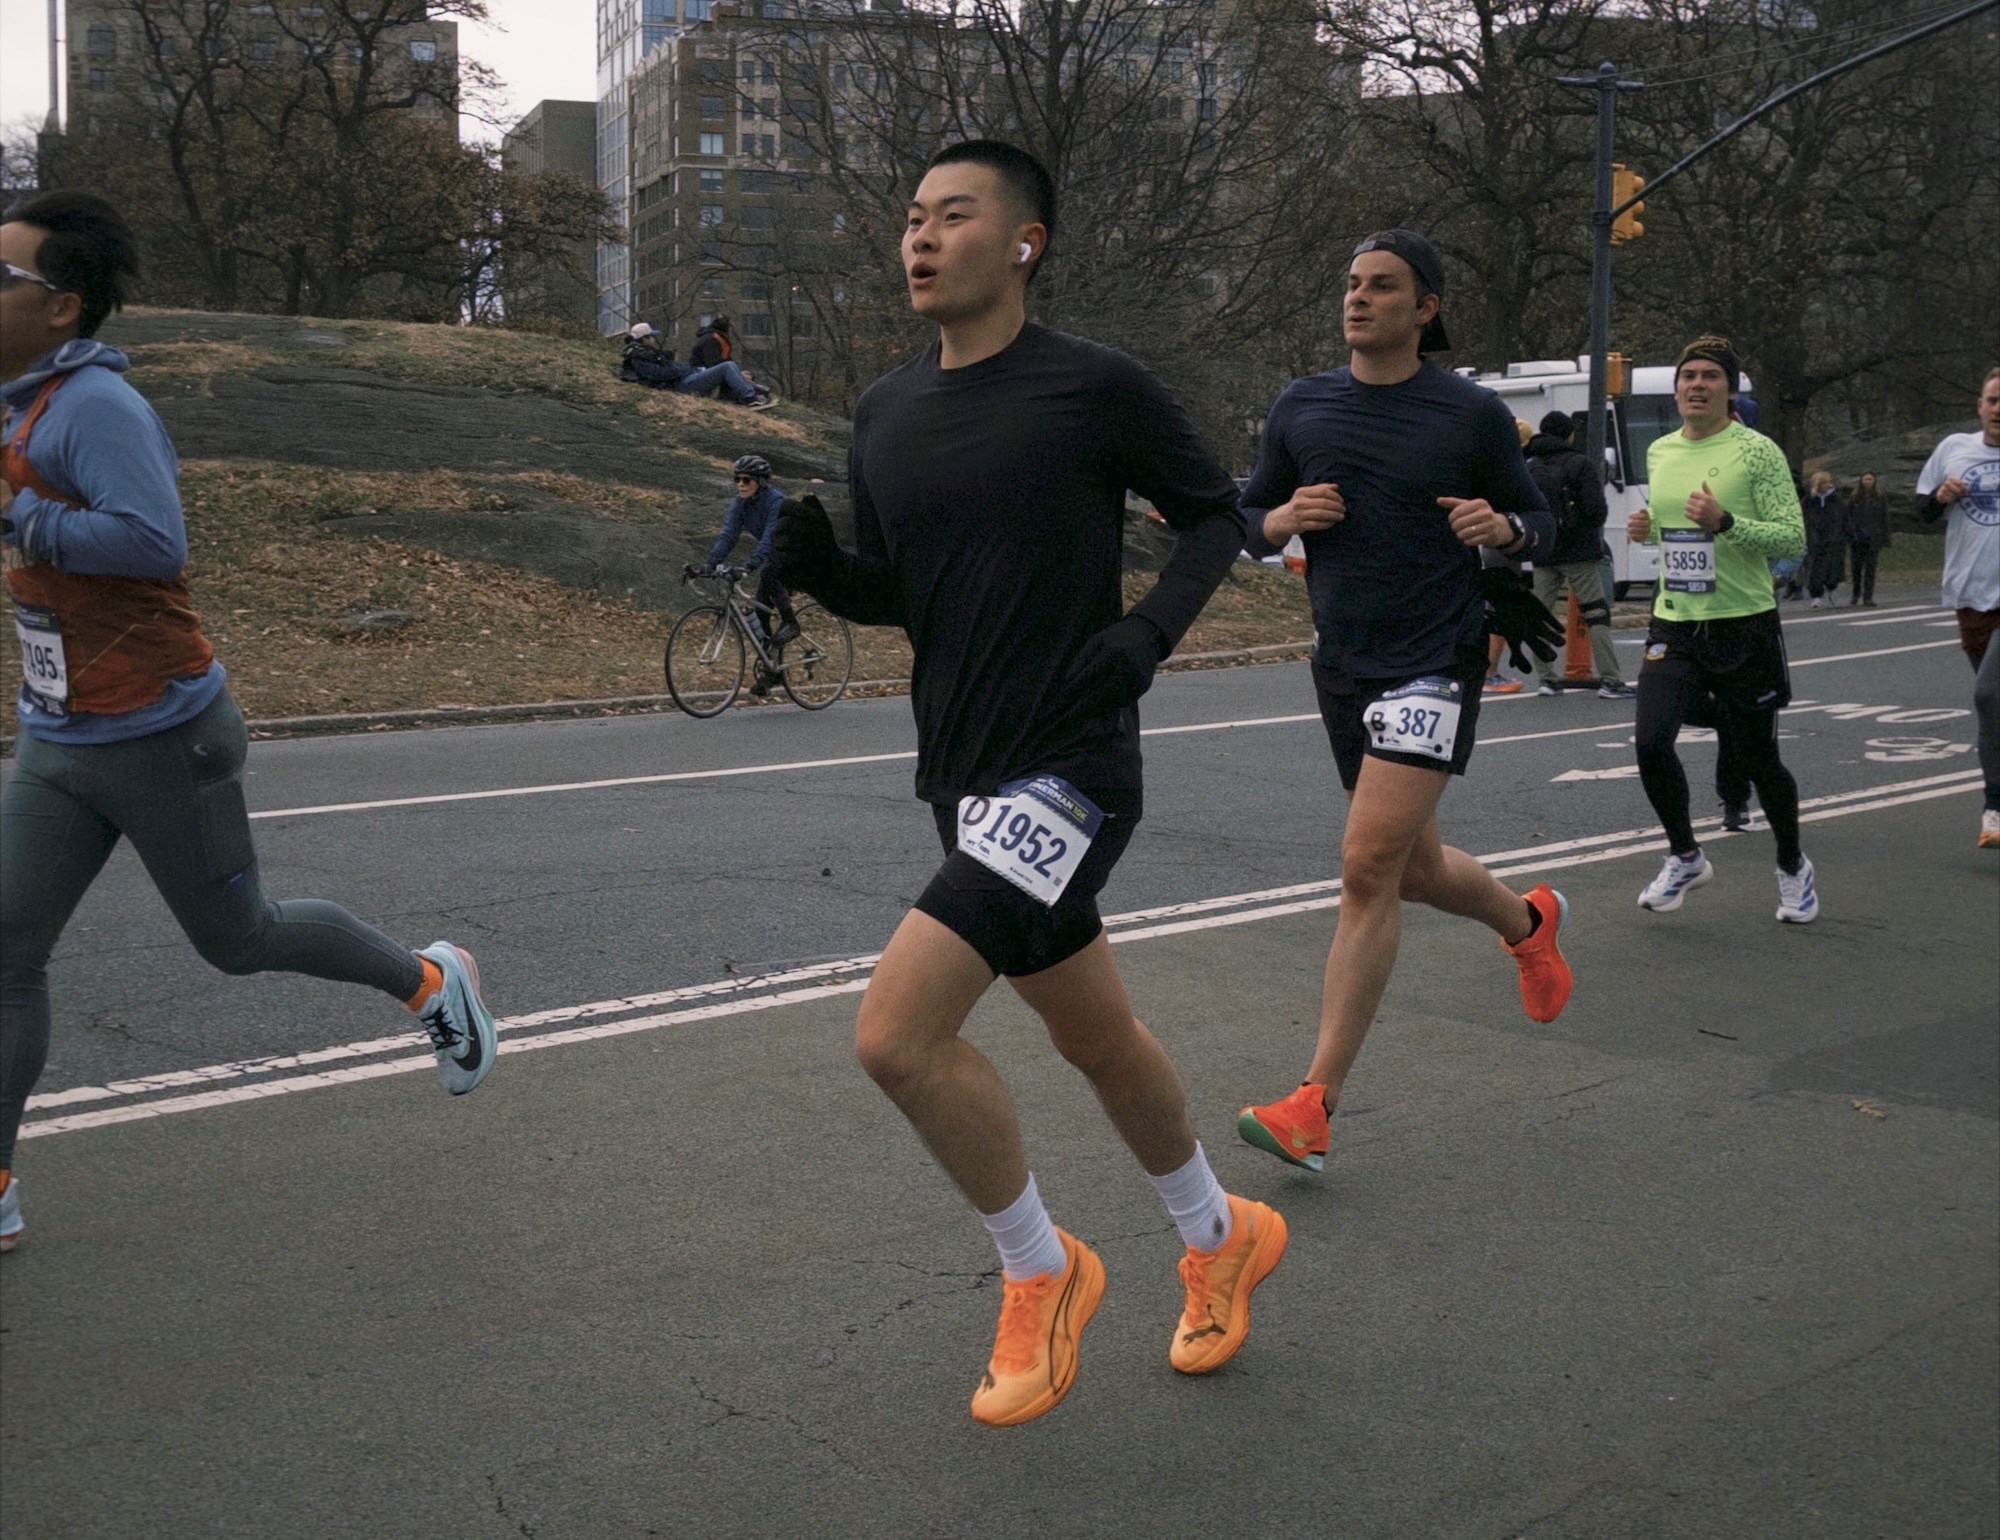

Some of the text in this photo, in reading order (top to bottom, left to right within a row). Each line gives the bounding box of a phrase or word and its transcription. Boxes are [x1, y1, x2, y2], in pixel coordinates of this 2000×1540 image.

[1672, 551, 1707, 570] 5859
[1370, 707, 1442, 739] B 387
[962, 796, 991, 826] D
[982, 805, 1067, 878] 1952
